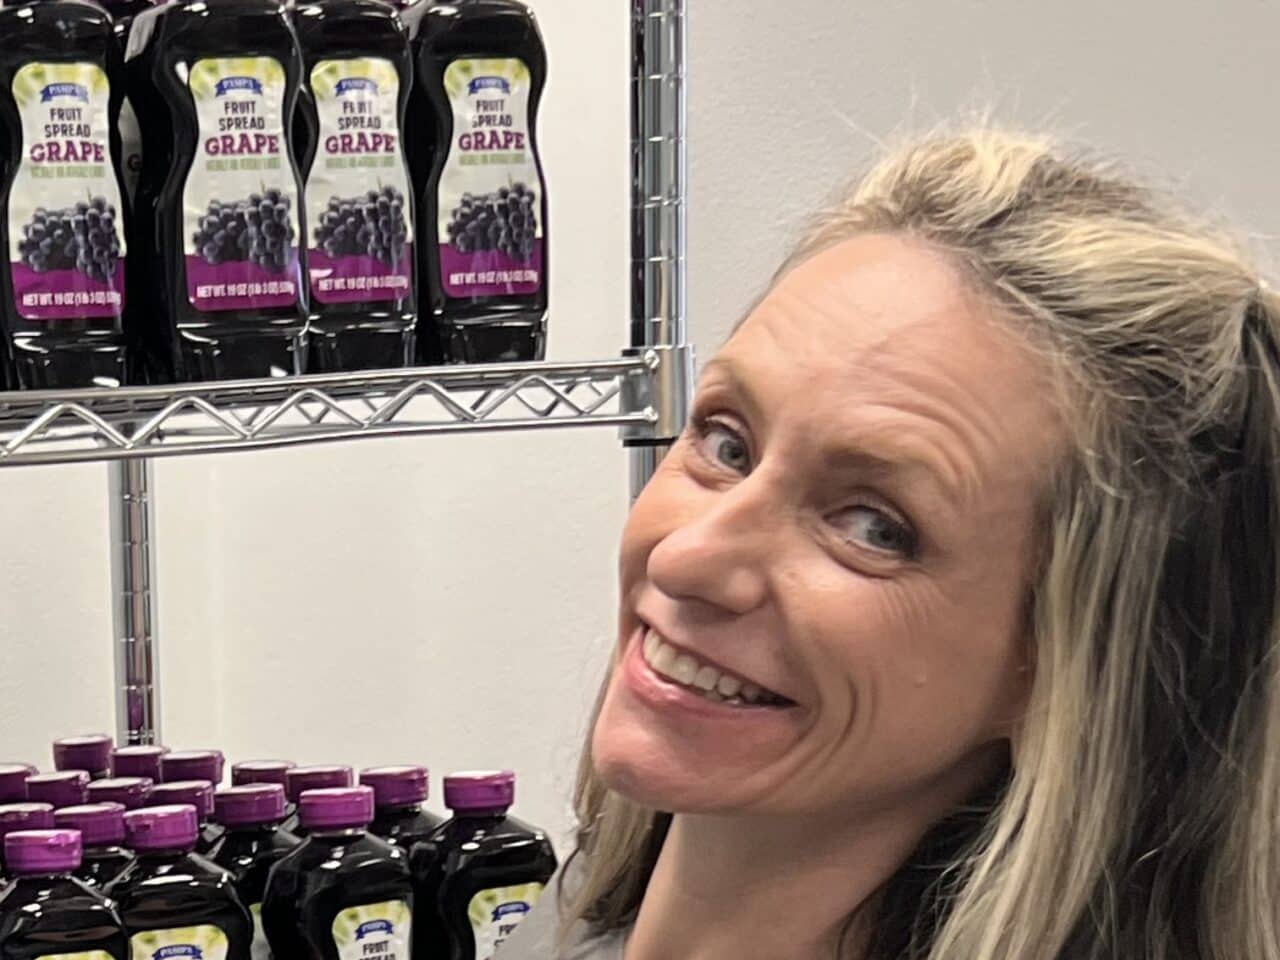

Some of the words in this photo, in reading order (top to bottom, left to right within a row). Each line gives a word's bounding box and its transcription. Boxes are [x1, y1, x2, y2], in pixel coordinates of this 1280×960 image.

[224, 101, 255, 115] FRUIT
[476, 100, 504, 113] FRUIT
[50, 108, 82, 121] FRUIT
[219, 117, 264, 131] SPREAD
[339, 117, 381, 130] SPREAD
[44, 124, 91, 139] SPREAD
[205, 134, 279, 156] GRAPE
[325, 133, 395, 154] GRAPE
[459, 131, 525, 150] GRAPE
[30, 141, 104, 163] GRAPE
[363, 941, 388, 955] FRUIT
